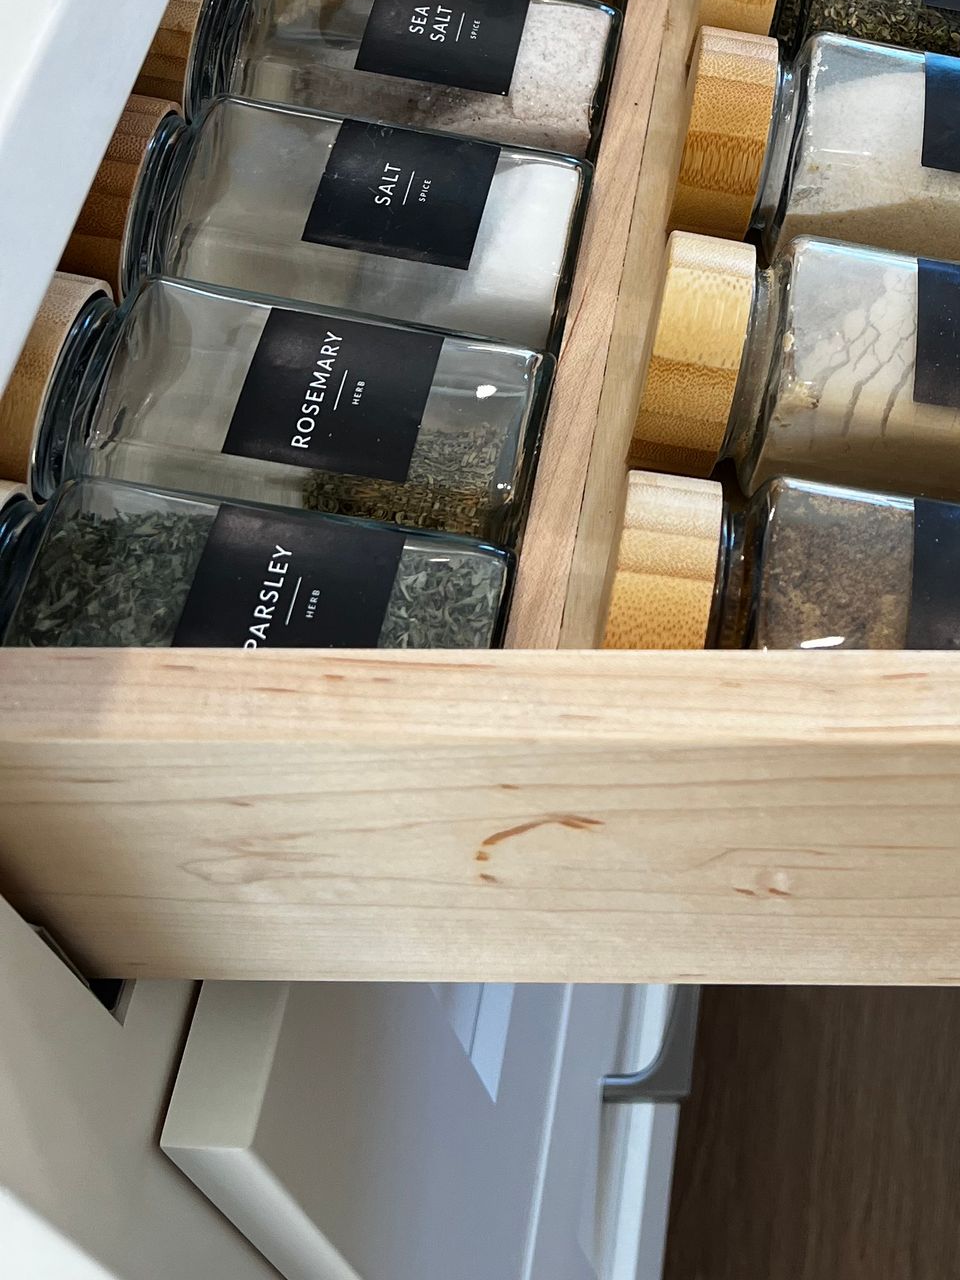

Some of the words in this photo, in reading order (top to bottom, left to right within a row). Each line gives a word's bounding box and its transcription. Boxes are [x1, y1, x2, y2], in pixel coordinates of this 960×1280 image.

[408, 6, 431, 35] SEA
[429, 5, 453, 43] SALT
[469, 20, 481, 40] SPICE
[374, 162, 402, 206] SALT
[418, 179, 432, 203] SPICE
[290, 331, 343, 449] ROSEMARY
[351, 380, 366, 405] HERB
[305, 589, 321, 618] HERB
